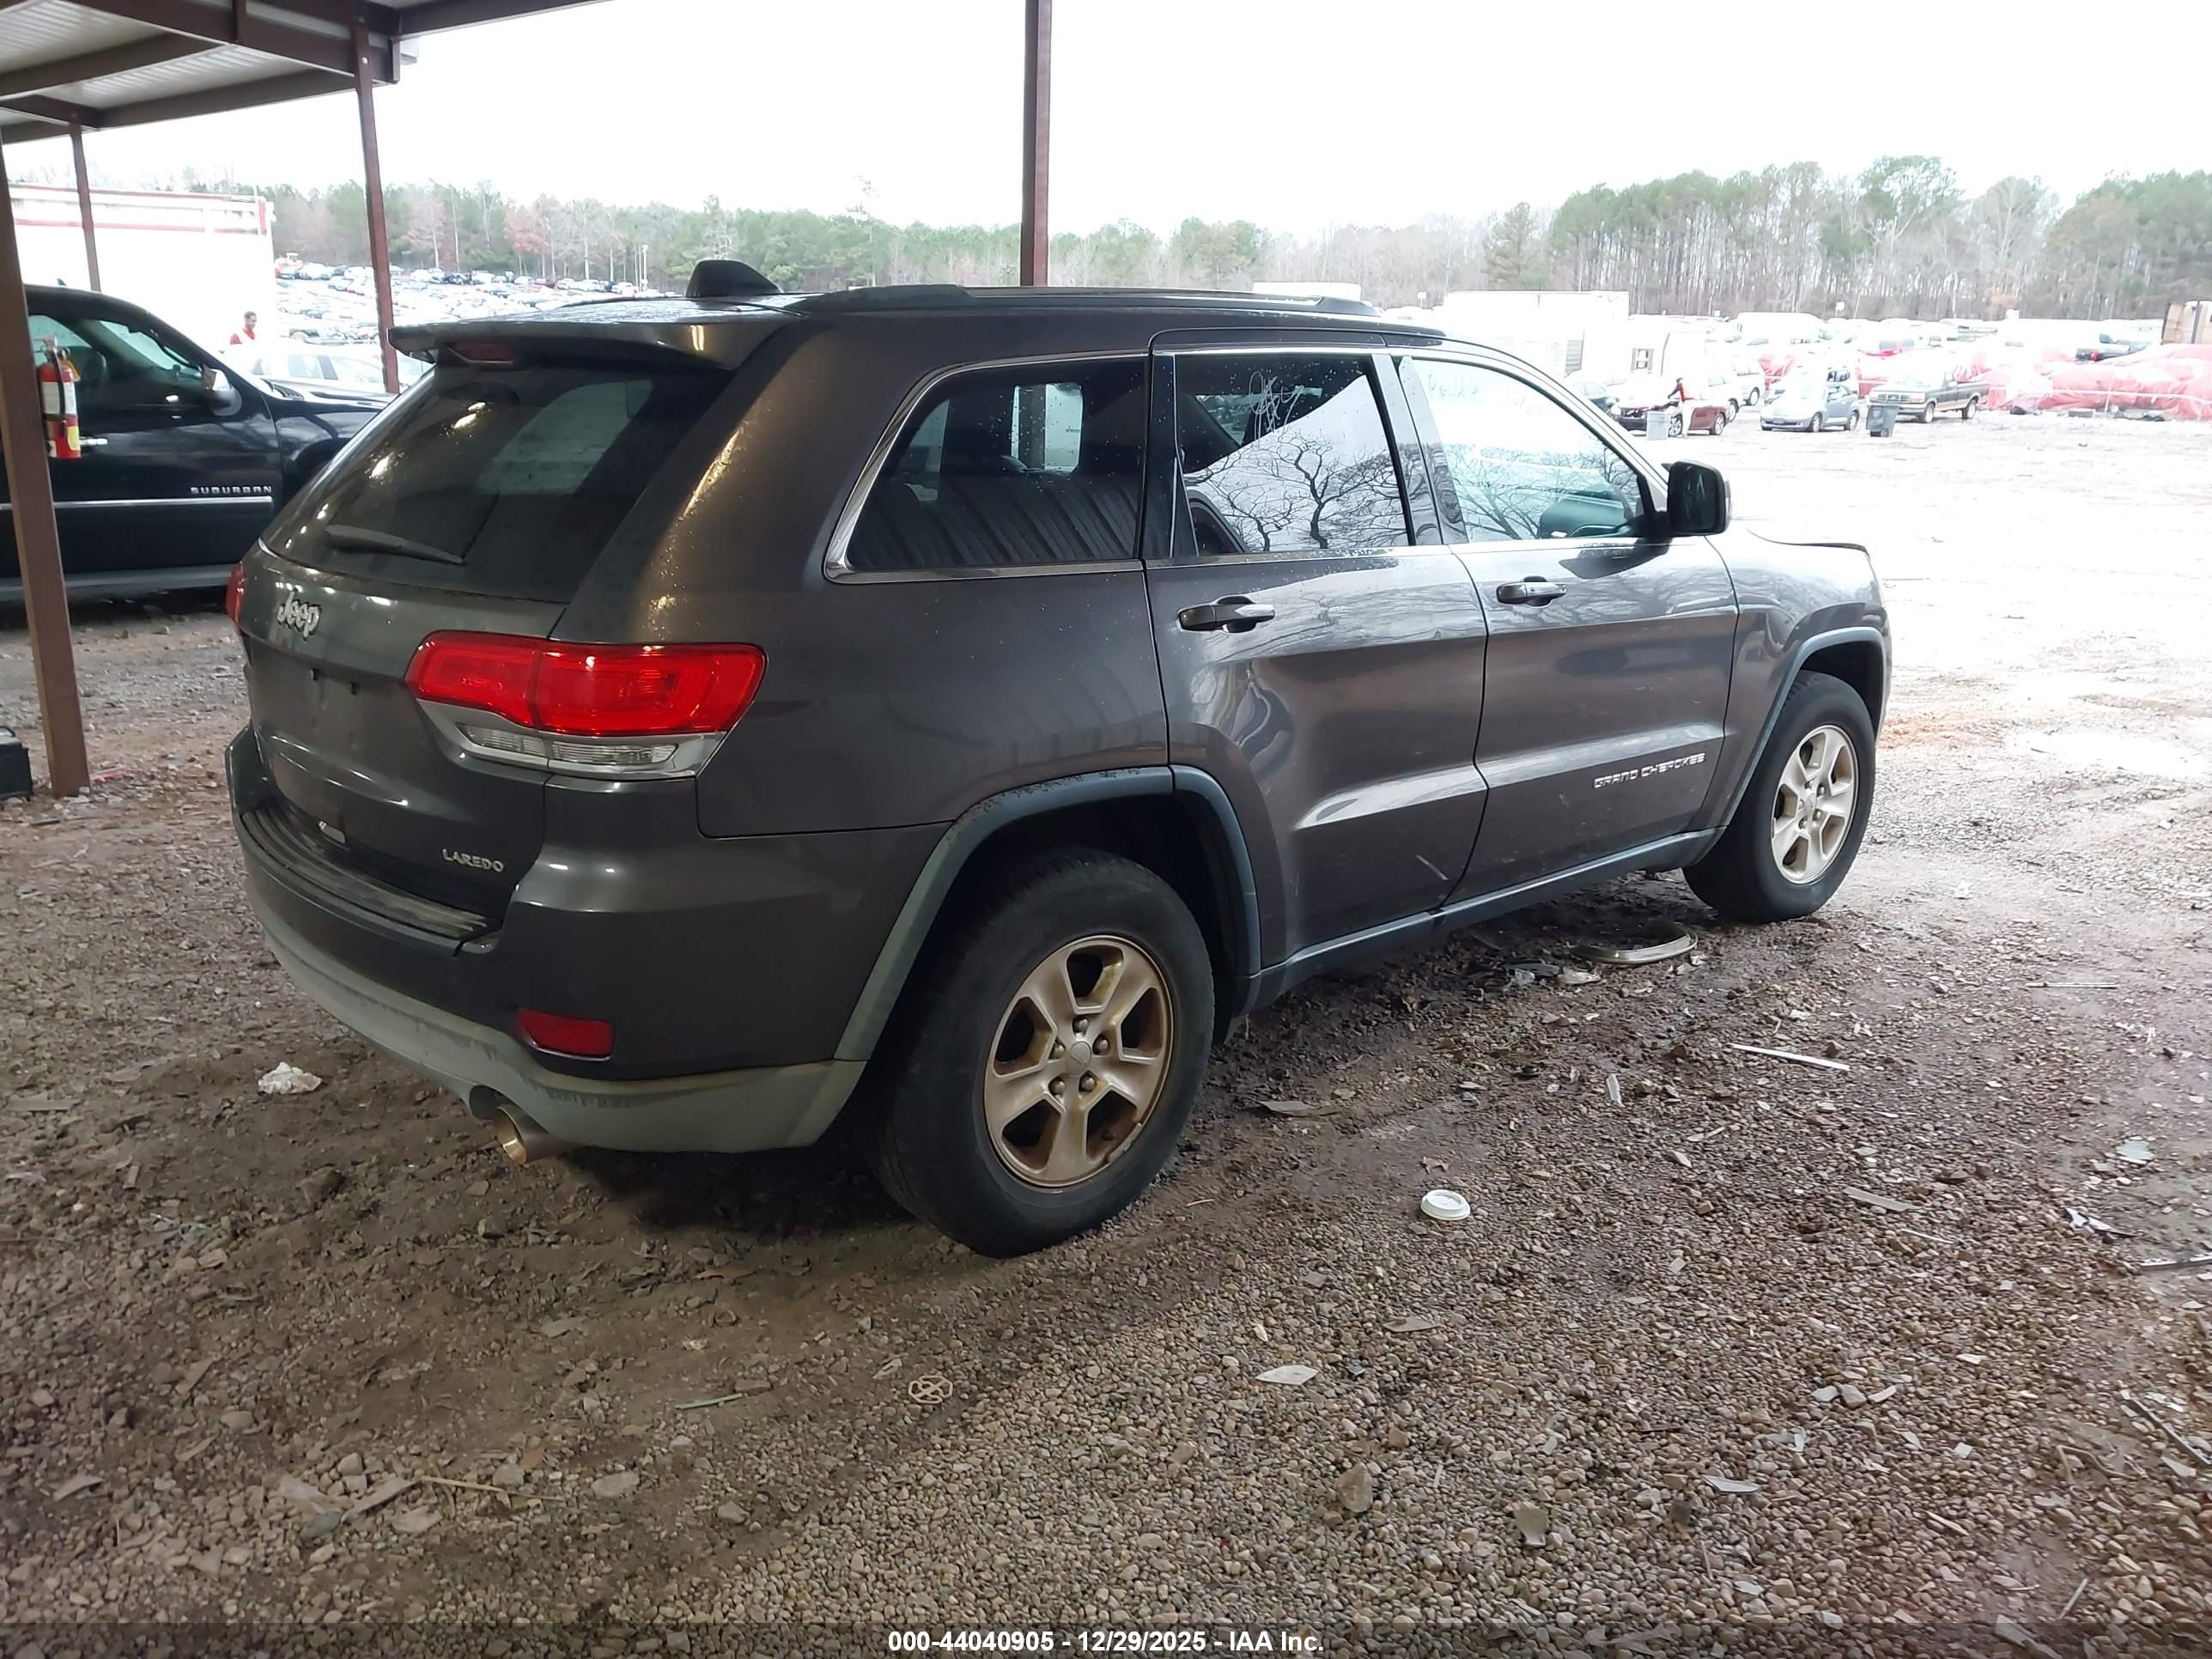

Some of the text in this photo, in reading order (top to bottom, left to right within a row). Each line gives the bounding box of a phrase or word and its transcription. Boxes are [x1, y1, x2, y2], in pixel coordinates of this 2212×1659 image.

[190, 486, 272, 495] SUBURBAN
[276, 591, 320, 638] Jeep
[1593, 752, 1705, 788] GRAND CHEROKEE
[441, 848, 505, 873] LAREDO
